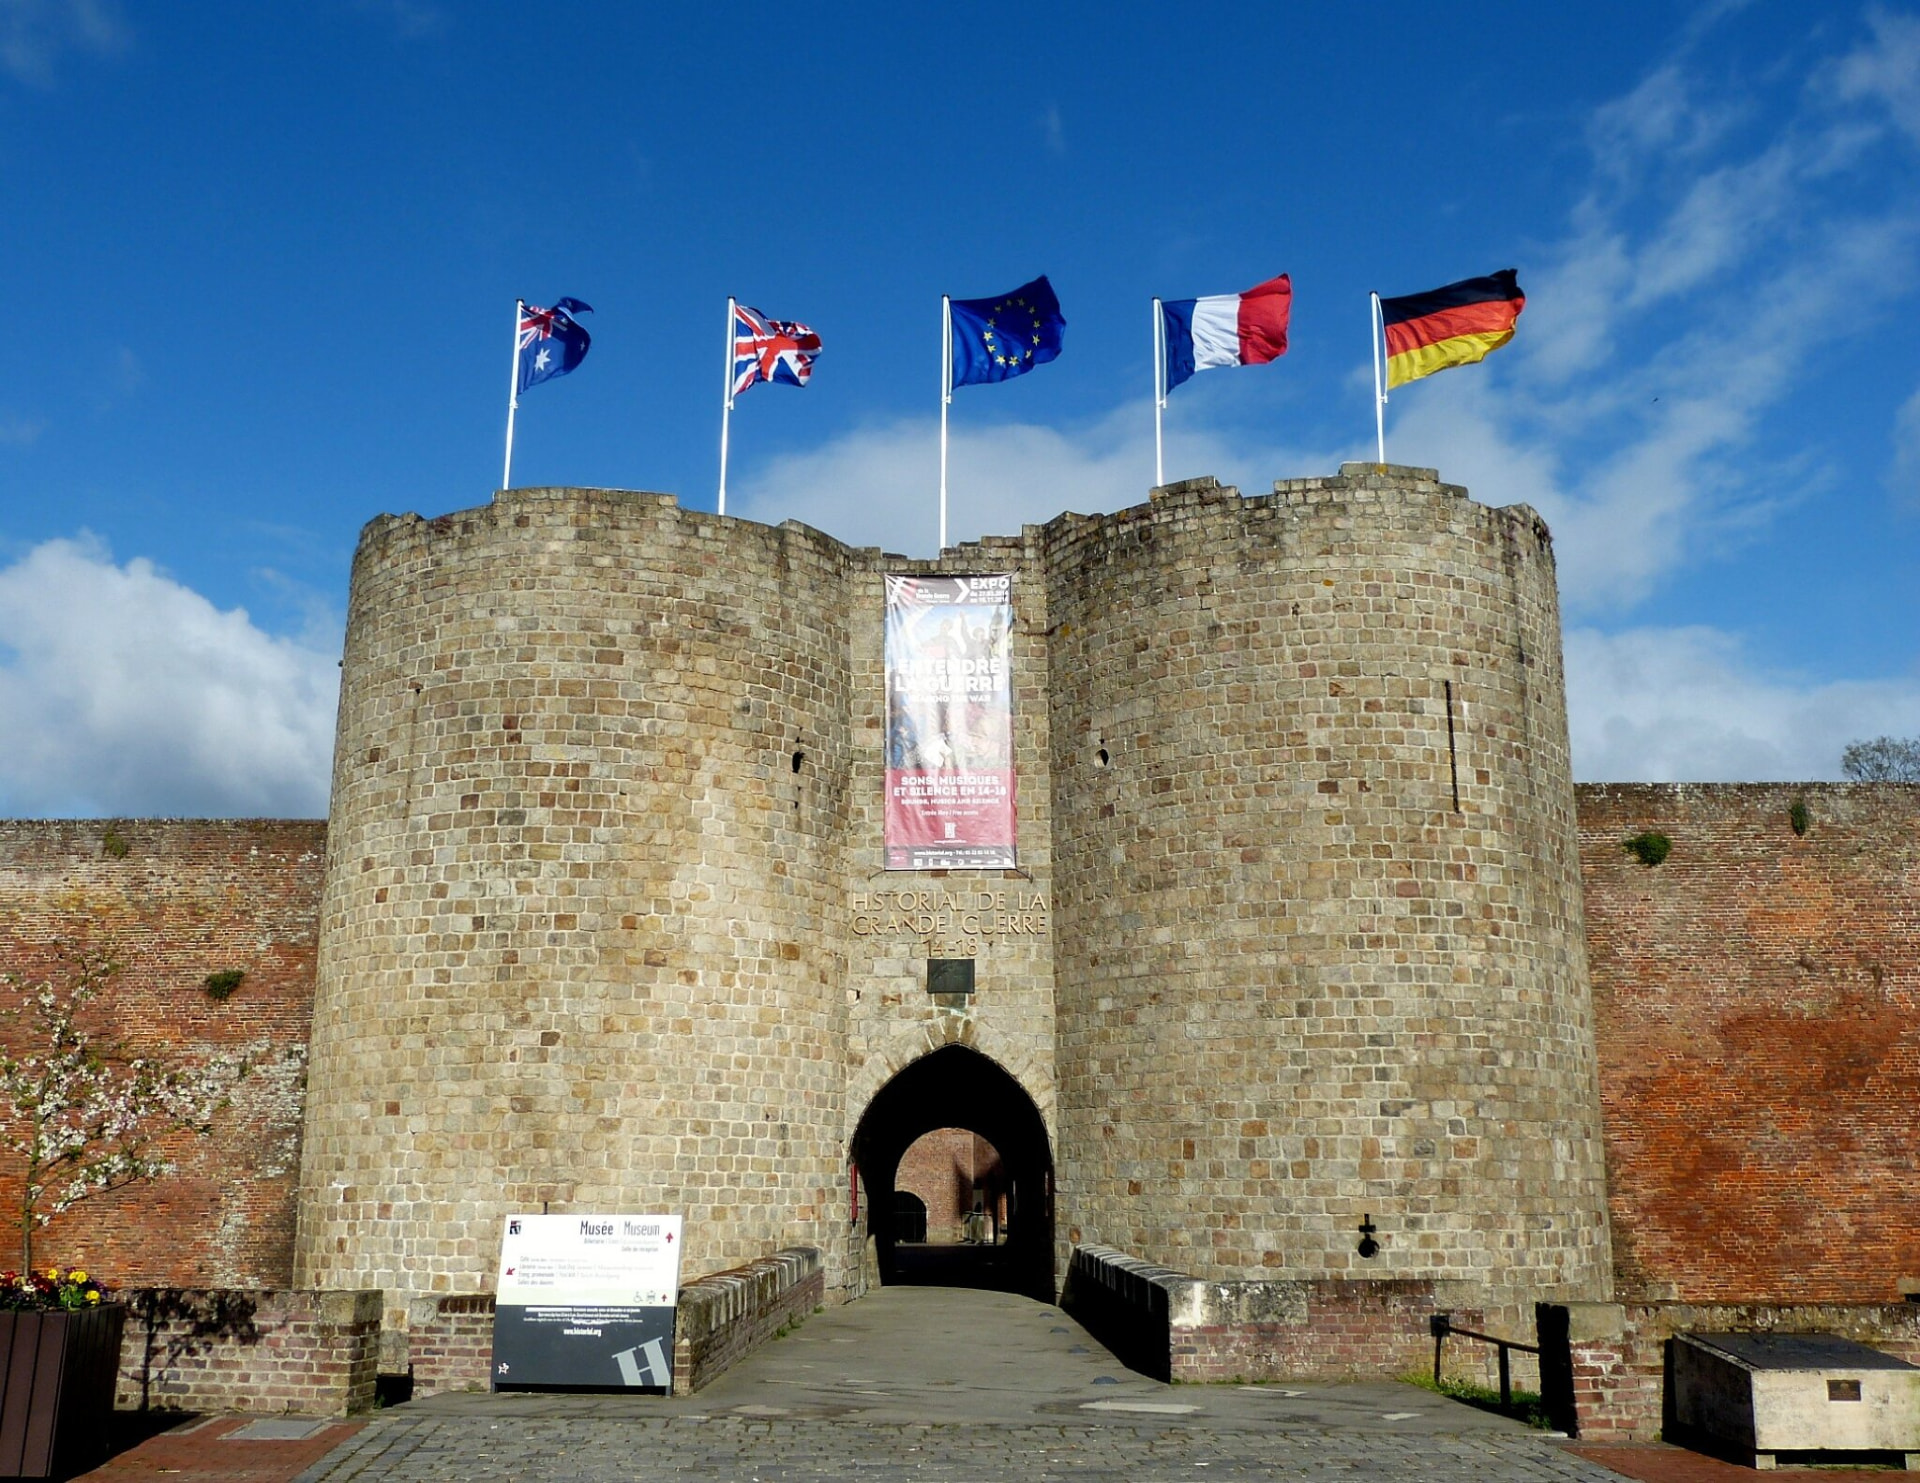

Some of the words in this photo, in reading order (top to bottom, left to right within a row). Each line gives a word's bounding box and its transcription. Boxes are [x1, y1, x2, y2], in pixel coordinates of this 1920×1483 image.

[970, 577, 1009, 589] EXPO
[938, 775, 999, 785] MUSIQUES
[893, 787, 907, 796] ET
[909, 786, 958, 796] SILENCE
[960, 786, 977, 795] EN
[978, 786, 1007, 796] 14-18
[852, 891, 965, 912] HISTORIAL
[978, 891, 1005, 911] DE
[1018, 891, 1046, 911] LA
[852, 915, 946, 935] GRANDE
[962, 915, 1046, 935] GUERRE
[580, 1219, 614, 1236] Musée
[624, 1220, 660, 1236] Museum
